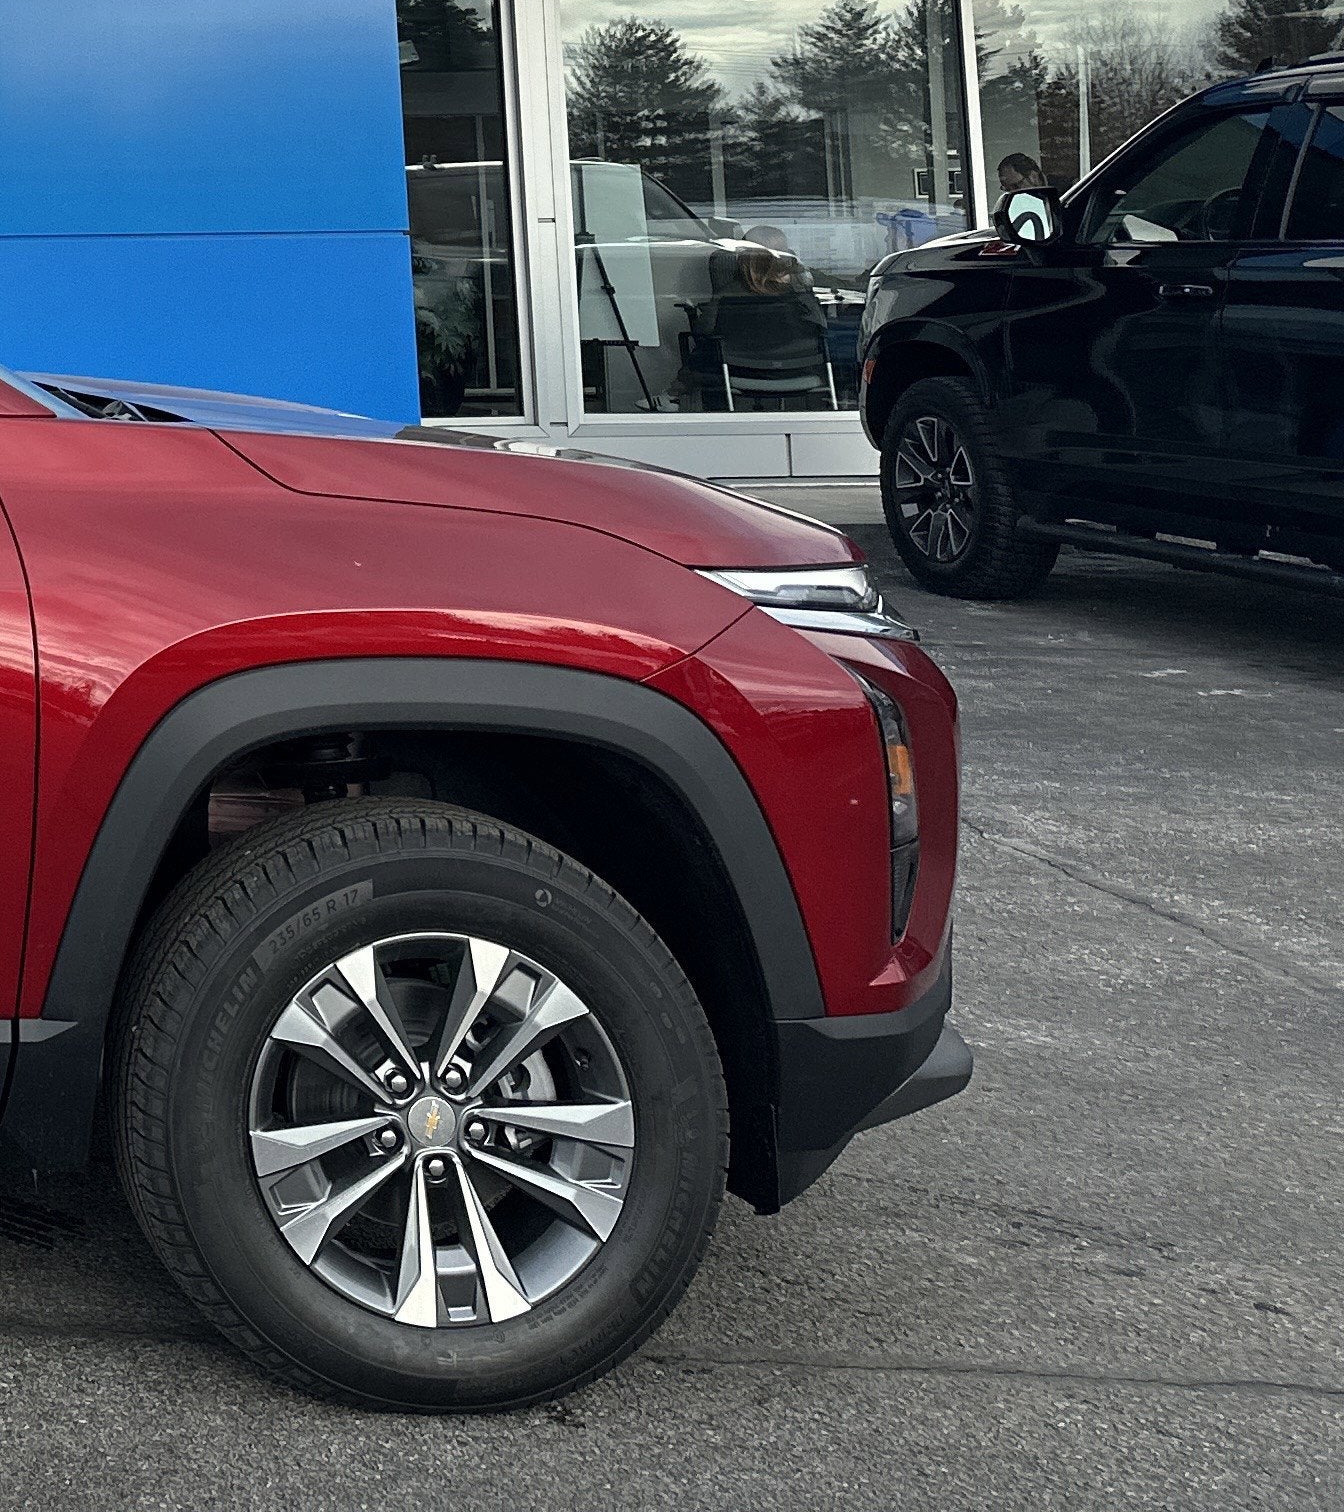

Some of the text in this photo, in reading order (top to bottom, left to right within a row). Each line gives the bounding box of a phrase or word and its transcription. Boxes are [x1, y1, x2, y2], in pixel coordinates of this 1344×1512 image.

[268, 889, 360, 954] 235/65 R 17
